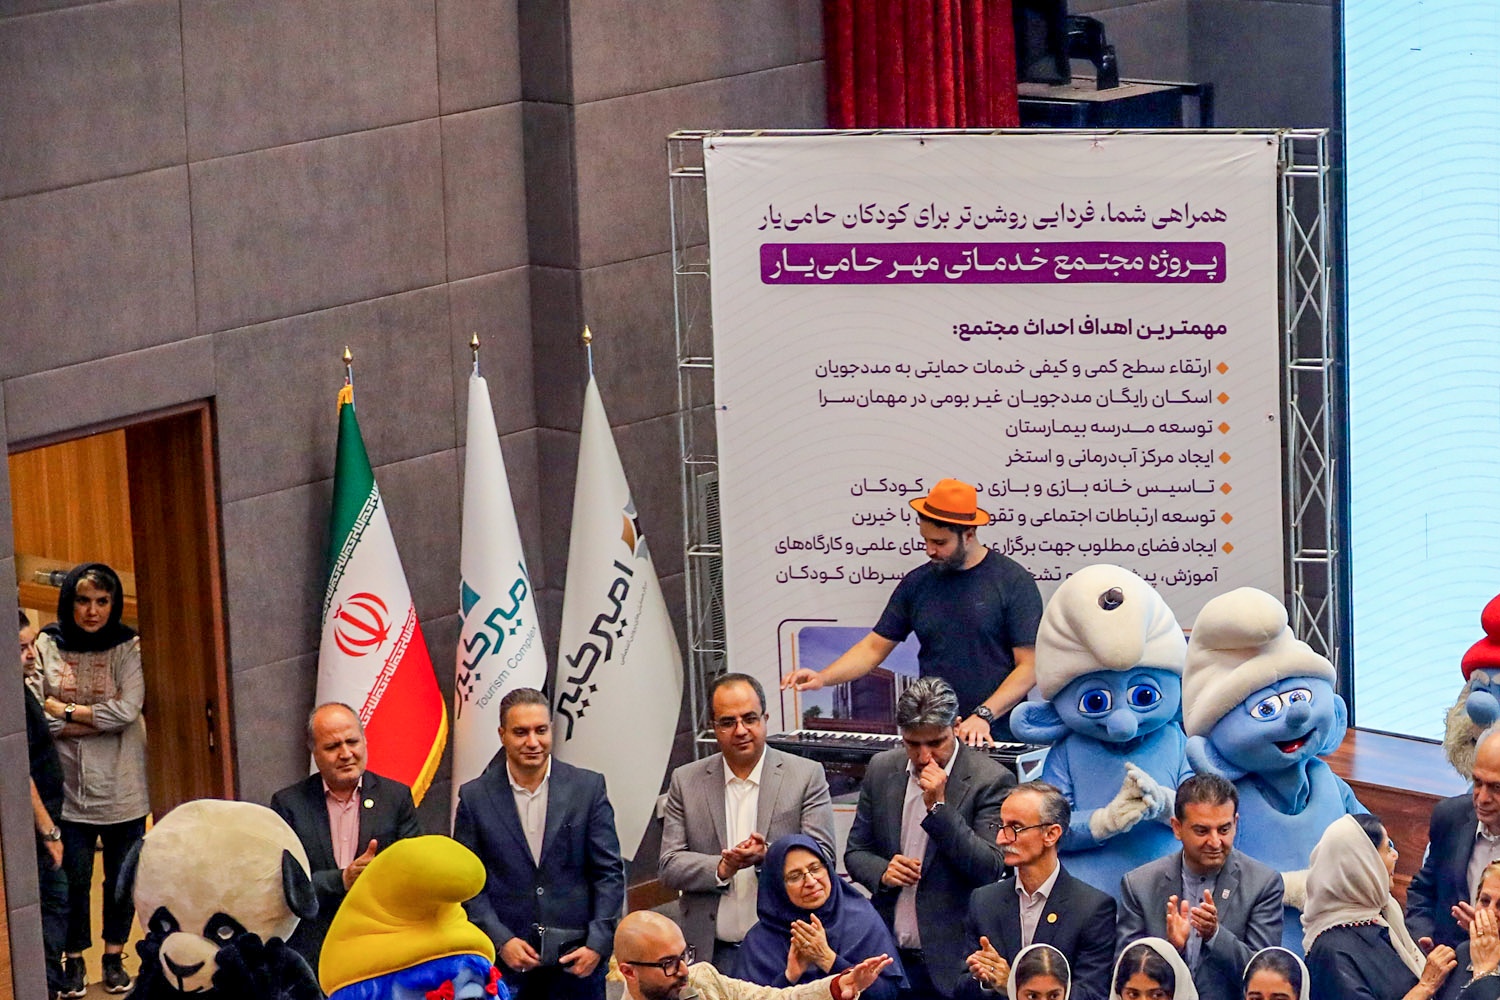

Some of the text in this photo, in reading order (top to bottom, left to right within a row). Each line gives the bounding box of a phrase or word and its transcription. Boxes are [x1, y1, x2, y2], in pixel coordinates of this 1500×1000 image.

[842, 202, 910, 230] کودکان
[913, 203, 950, 230] برای
[1032, 200, 1095, 230] فردایی
[1100, 202, 1147, 223] شما،
[1151, 202, 1228, 230] همراهی
[886, 254, 939, 279] مهر
[944, 247, 1048, 280] خدماتی
[1053, 253, 1144, 280] مجتمع
[1149, 249, 1218, 280] پروژه
[952, 314, 1228, 341] مهمترین اهداف احداث مجتمع:
[815, 359, 1211, 378] ارتقاء سطح کمی و کیفی خدمات حمایتی به مددجویان
[910, 394, 926, 407] در
[930, 394, 969, 408] بومی
[972, 389, 1003, 408] غیر
[1007, 389, 1092, 408] مددجویان
[1096, 387, 1148, 408] رایگان
[1152, 389, 1212, 408] اسکان
[1005, 419, 1213, 438] توسعه مدرسه بیمارستان
[1005, 449, 1052, 467] استخر
[1056, 454, 1064, 467] و
[1140, 449, 1174, 467] مرکز
[1178, 449, 1214, 468] ایجاد
[851, 478, 923, 497] کودکان
[988, 479, 1029, 497] بازی
[1033, 483, 1042, 497] و
[1046, 479, 1088, 497] بازی
[1093, 479, 1132, 493] خانه
[1137, 479, 1215, 498] تاسیس
[852, 508, 896, 526] خیرین
[900, 508, 910, 526] با
[1018, 513, 1026, 526] و
[1030, 508, 1091, 527] اجتماعی
[1096, 508, 1157, 527] ارتباطات
[1161, 509, 1216, 527] توسعه
[845, 542, 854, 555] و
[856, 537, 896, 556] علمی
[1038, 540, 1075, 555] جهت
[1078, 538, 1134, 556] مطلوب
[1138, 537, 1179, 556] فضای
[1182, 538, 1216, 557] ایجاد
[775, 566, 844, 583] کودکان
[1161, 566, 1218, 587] آموزش،
[475, 625, 537, 710] Tourism Complex
